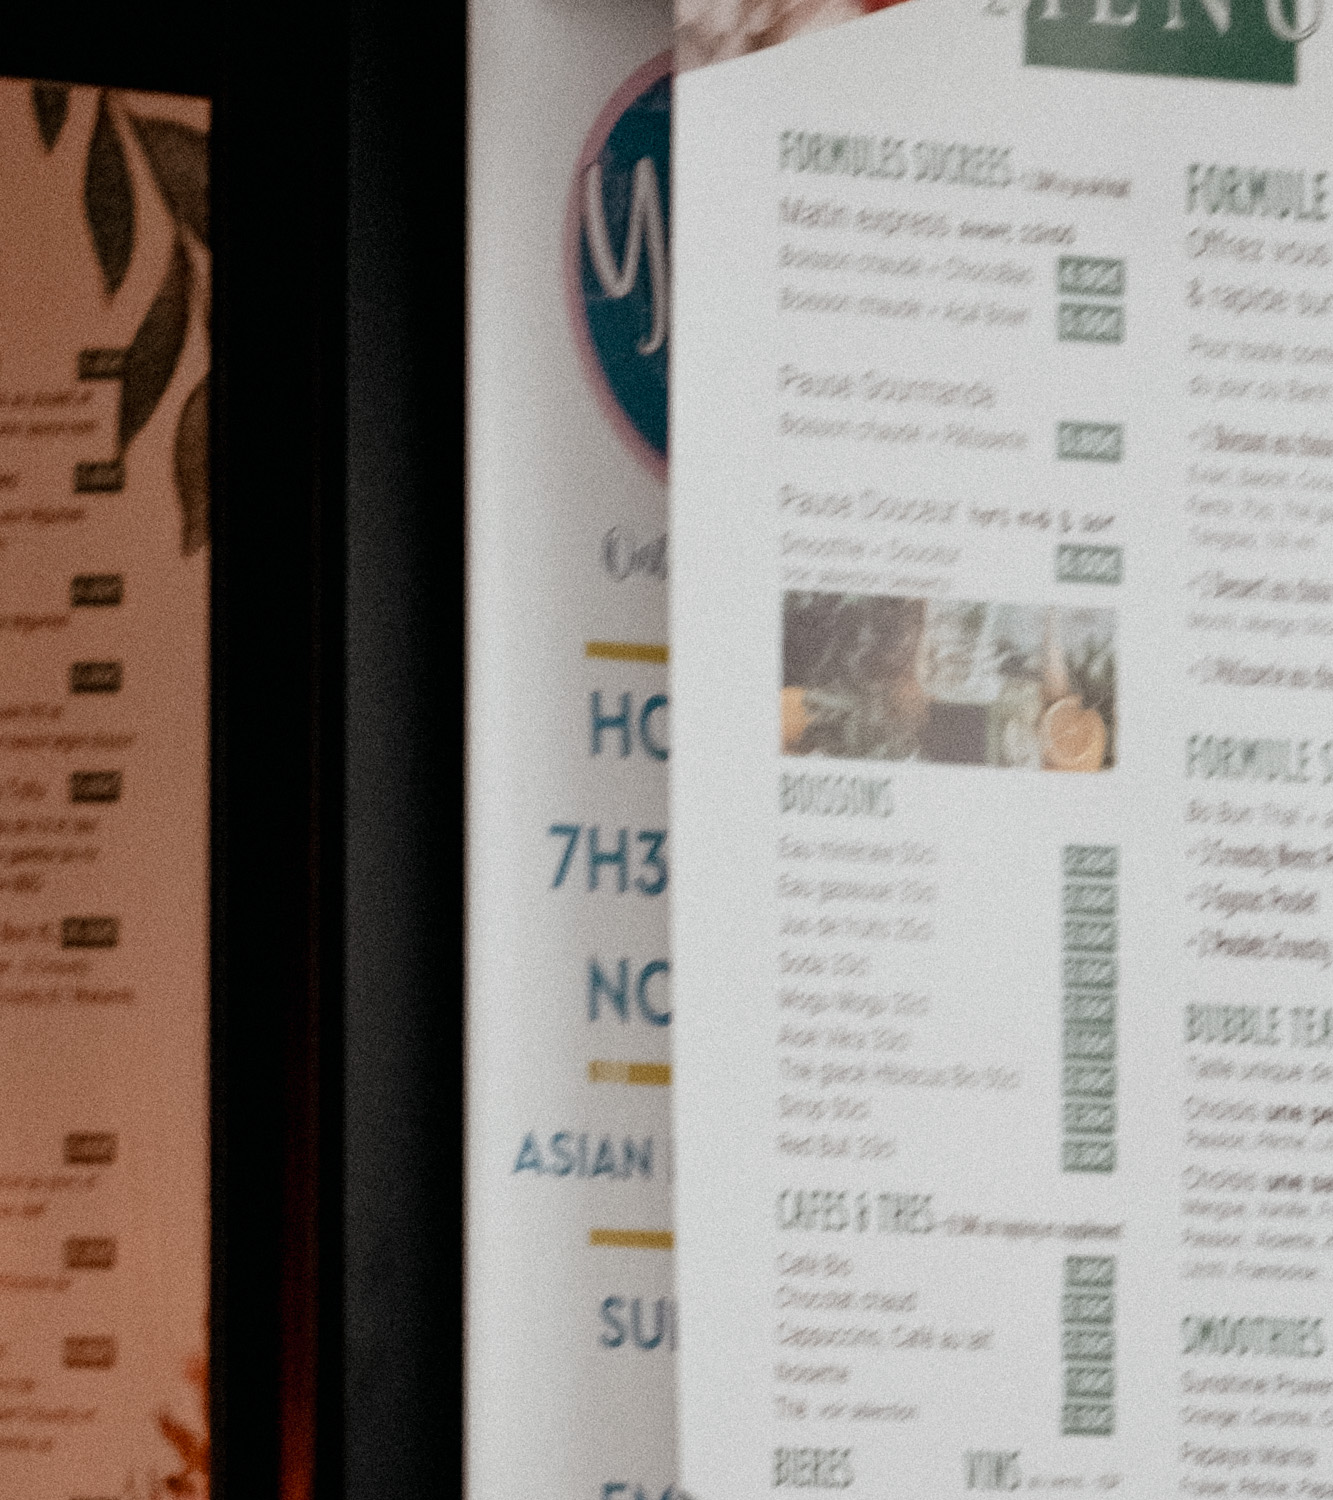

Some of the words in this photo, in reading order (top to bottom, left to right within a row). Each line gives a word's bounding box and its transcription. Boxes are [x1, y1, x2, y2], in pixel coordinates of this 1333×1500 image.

[779, 129, 906, 179] FORMULES
[1186, 161, 1327, 221] FORMULE
[1186, 734, 1311, 783] FORMULE
[779, 772, 895, 818] BOISSONS
[1185, 1003, 1282, 1046] BUBBLE
[512, 1131, 654, 1179] ASIAN
